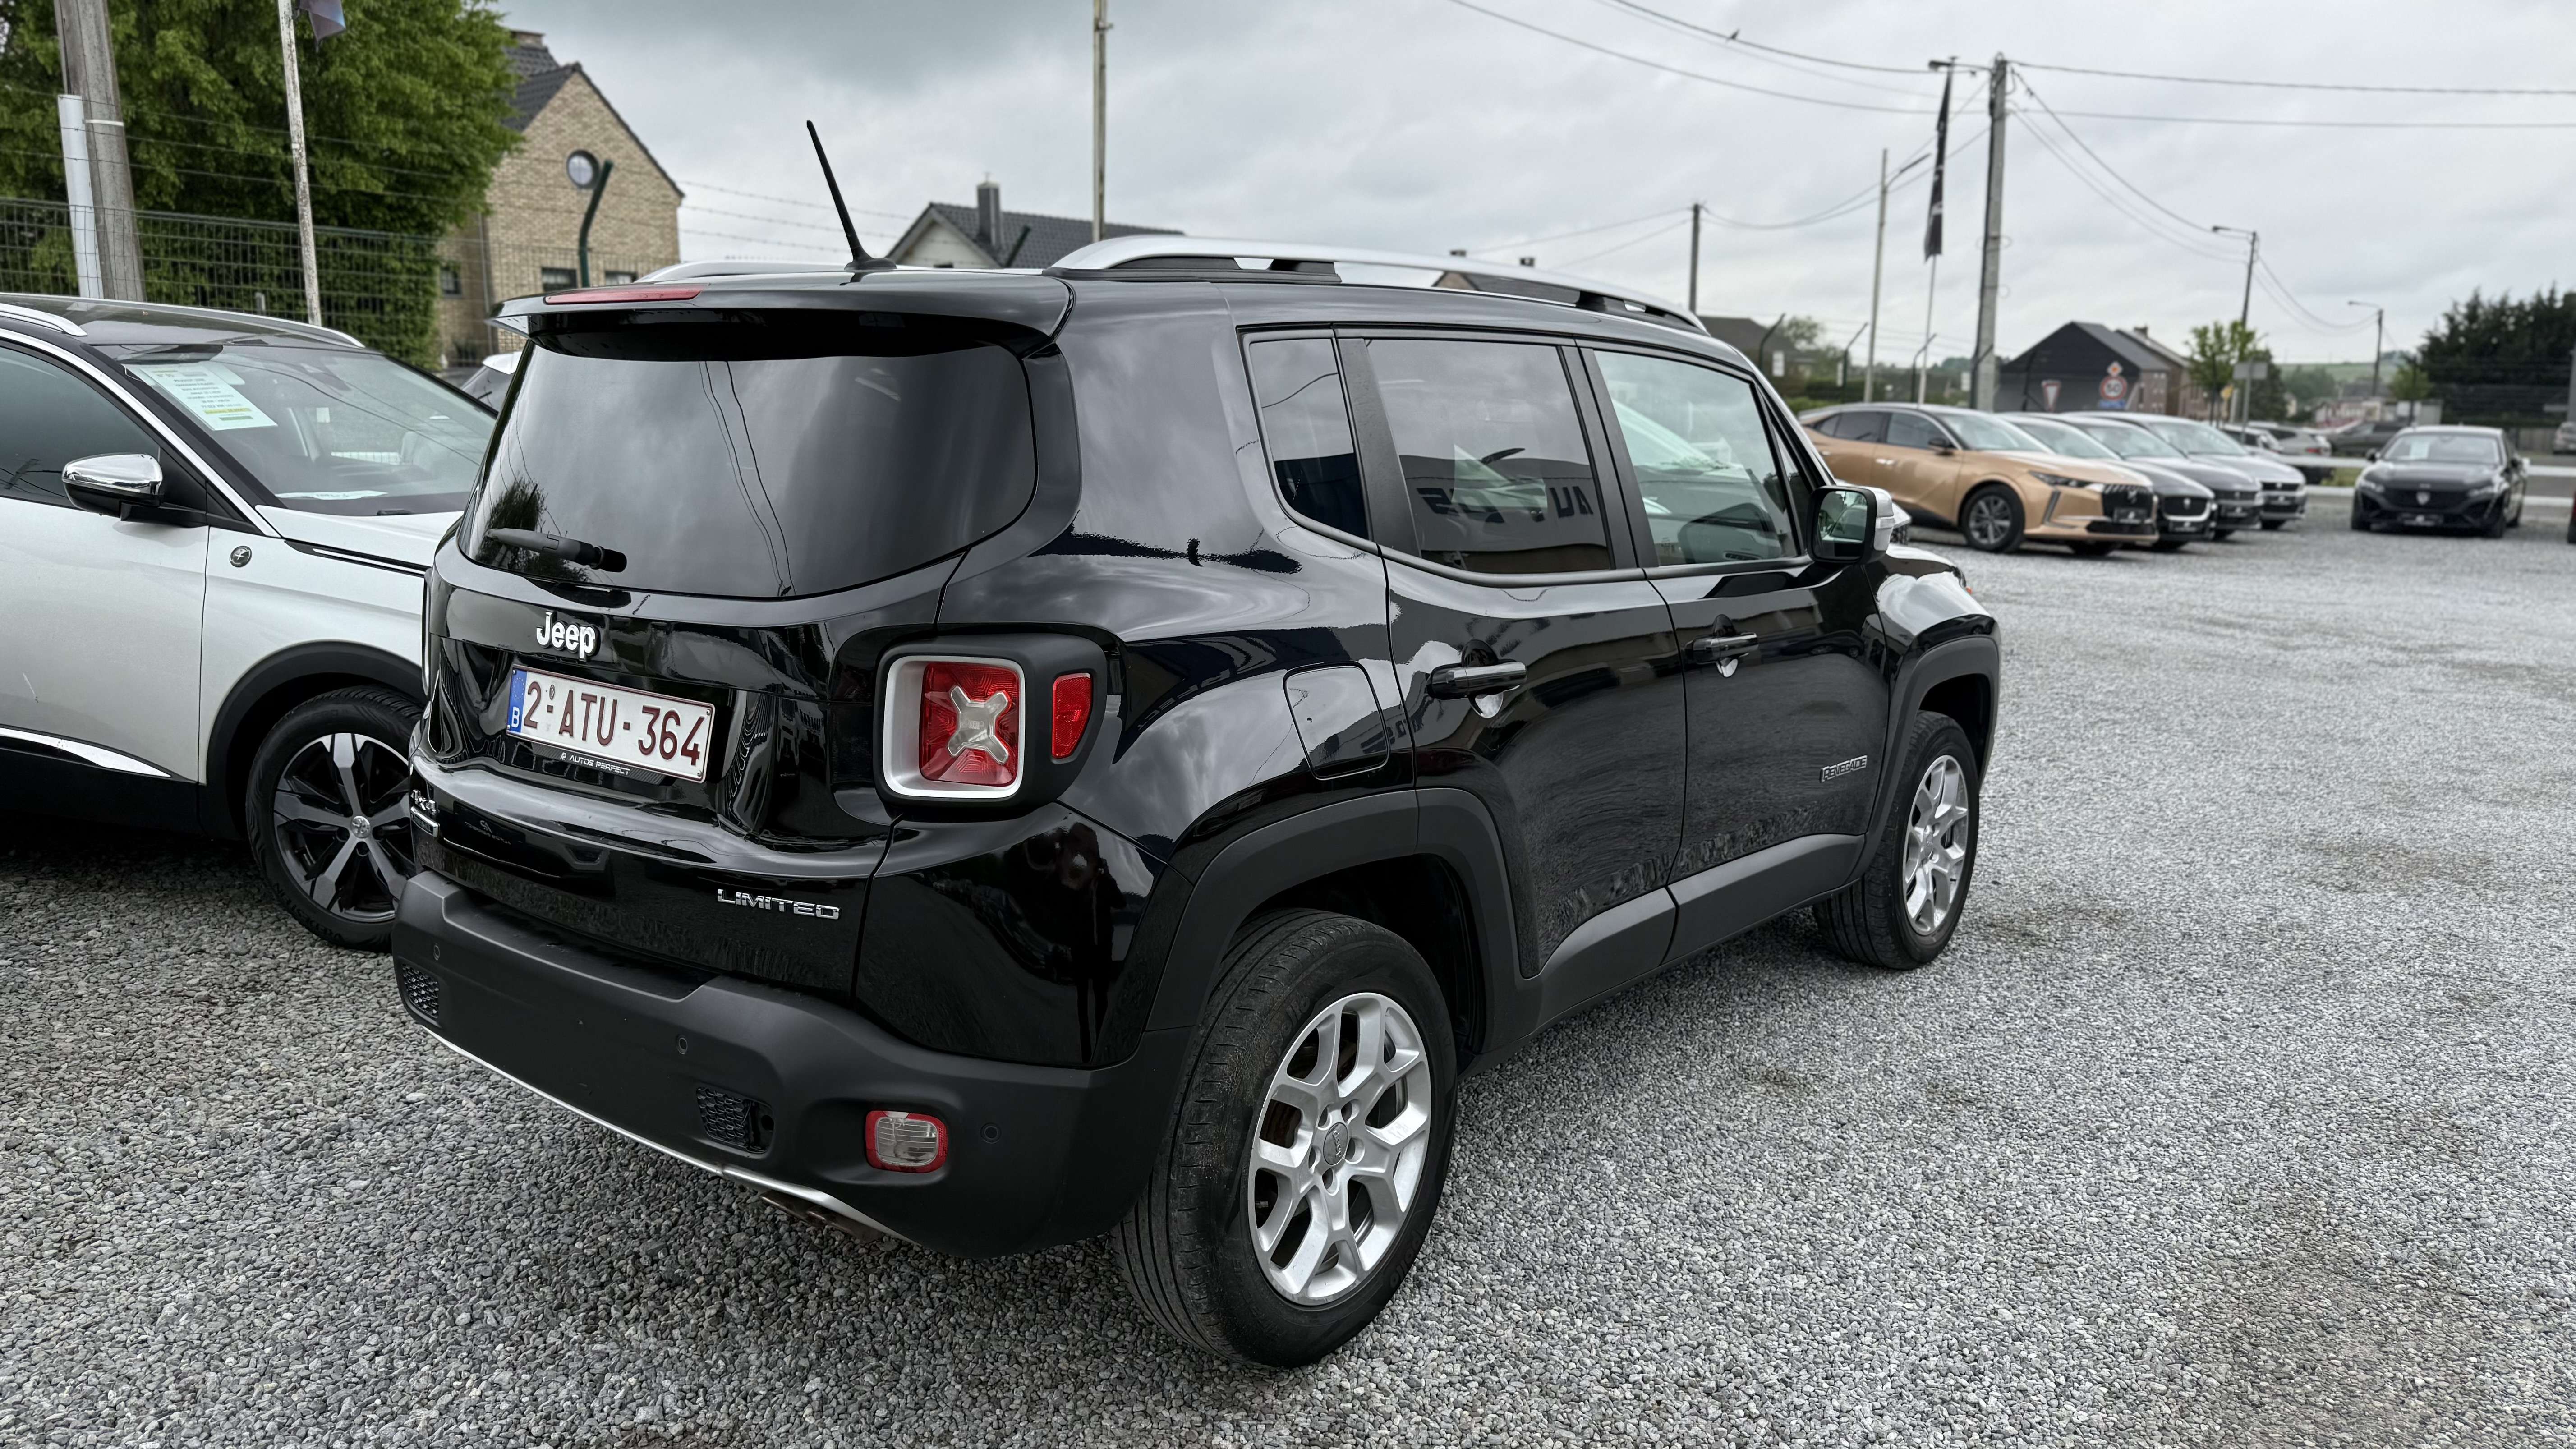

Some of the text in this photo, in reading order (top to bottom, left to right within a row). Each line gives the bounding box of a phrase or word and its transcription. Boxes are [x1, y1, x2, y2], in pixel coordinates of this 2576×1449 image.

[536, 611, 597, 660] Jeep
[512, 707, 520, 728] B
[570, 755, 630, 775] AUTOS PERFECT
[1822, 756, 1867, 782] RENEGADE
[718, 889, 841, 920] LIMITED
